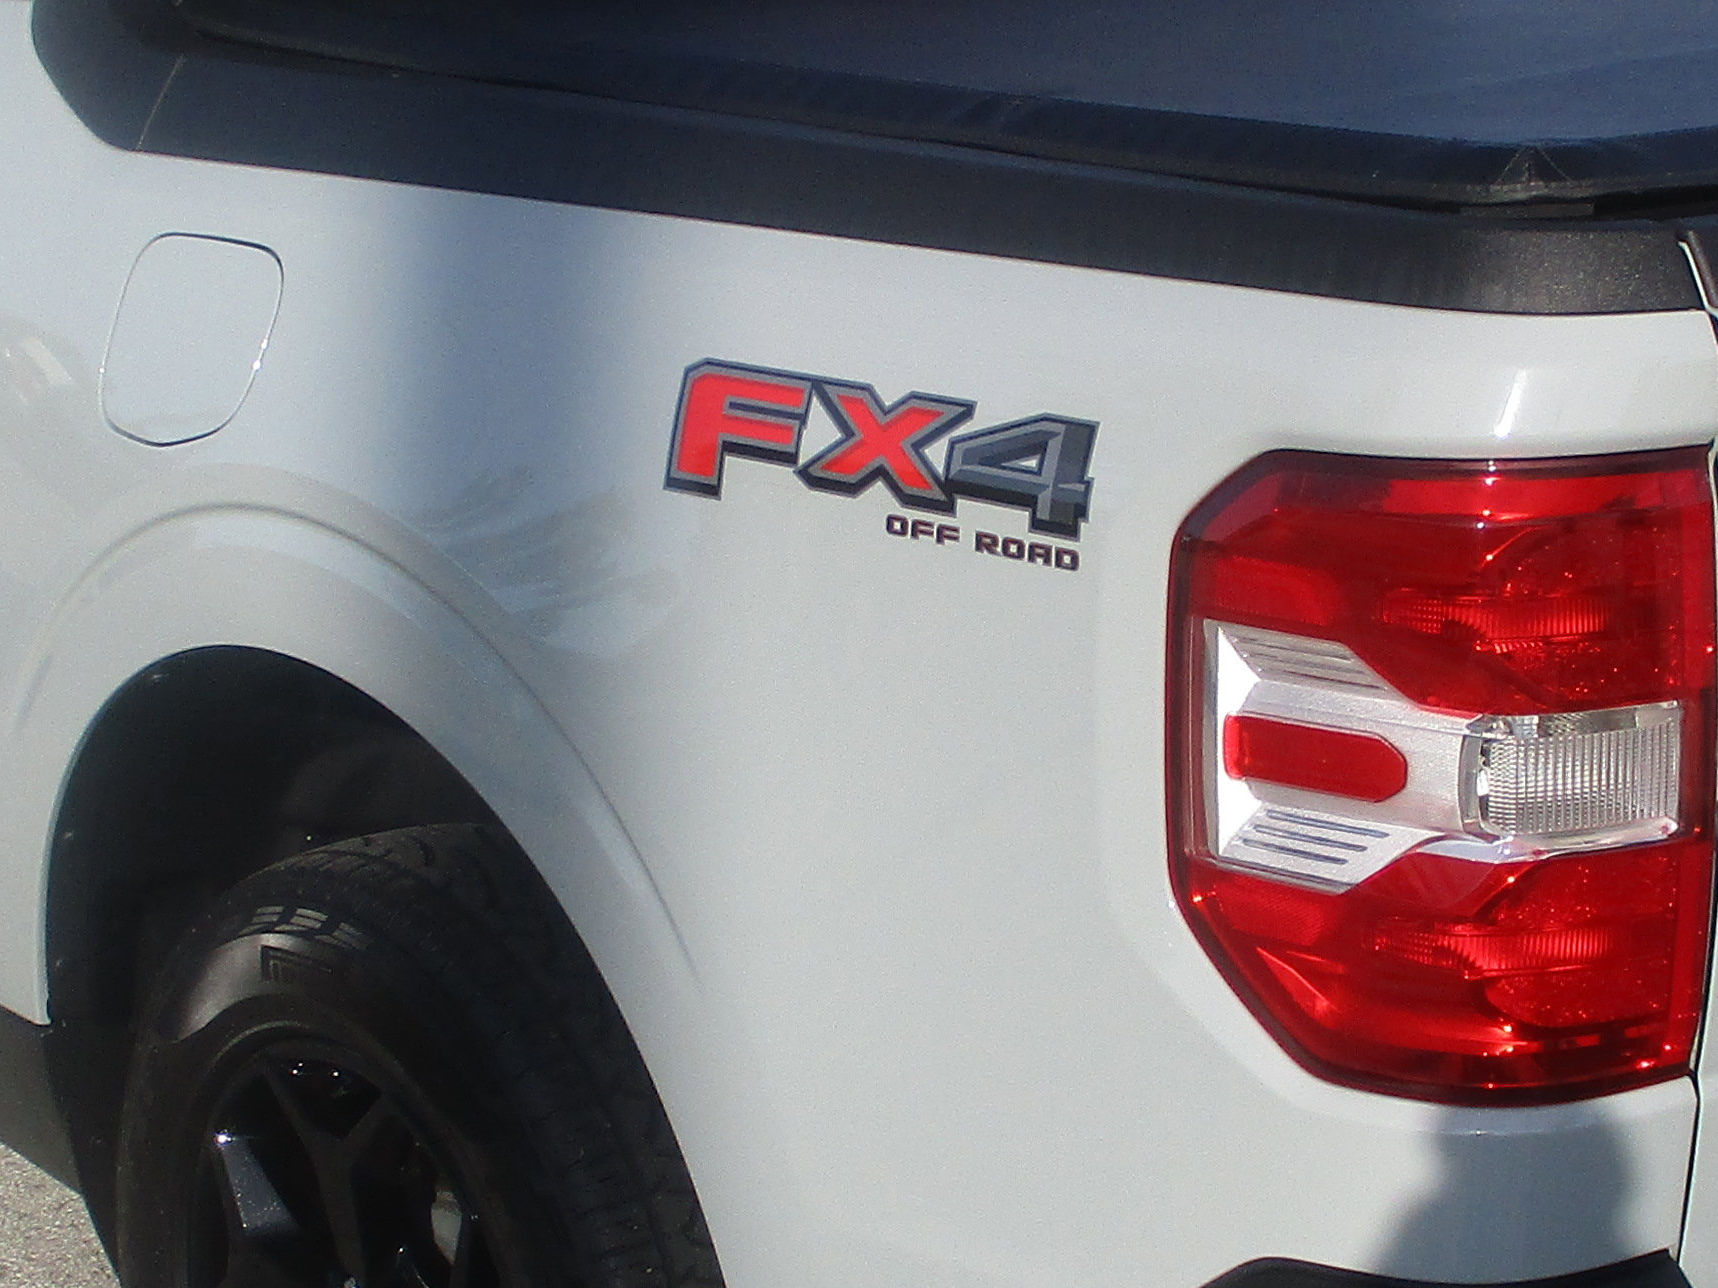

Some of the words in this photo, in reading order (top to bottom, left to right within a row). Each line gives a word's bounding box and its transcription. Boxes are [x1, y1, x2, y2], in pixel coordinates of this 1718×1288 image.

[662, 357, 1101, 543] FX4
[884, 513, 961, 547] OFF
[973, 529, 1081, 572] ROAD
